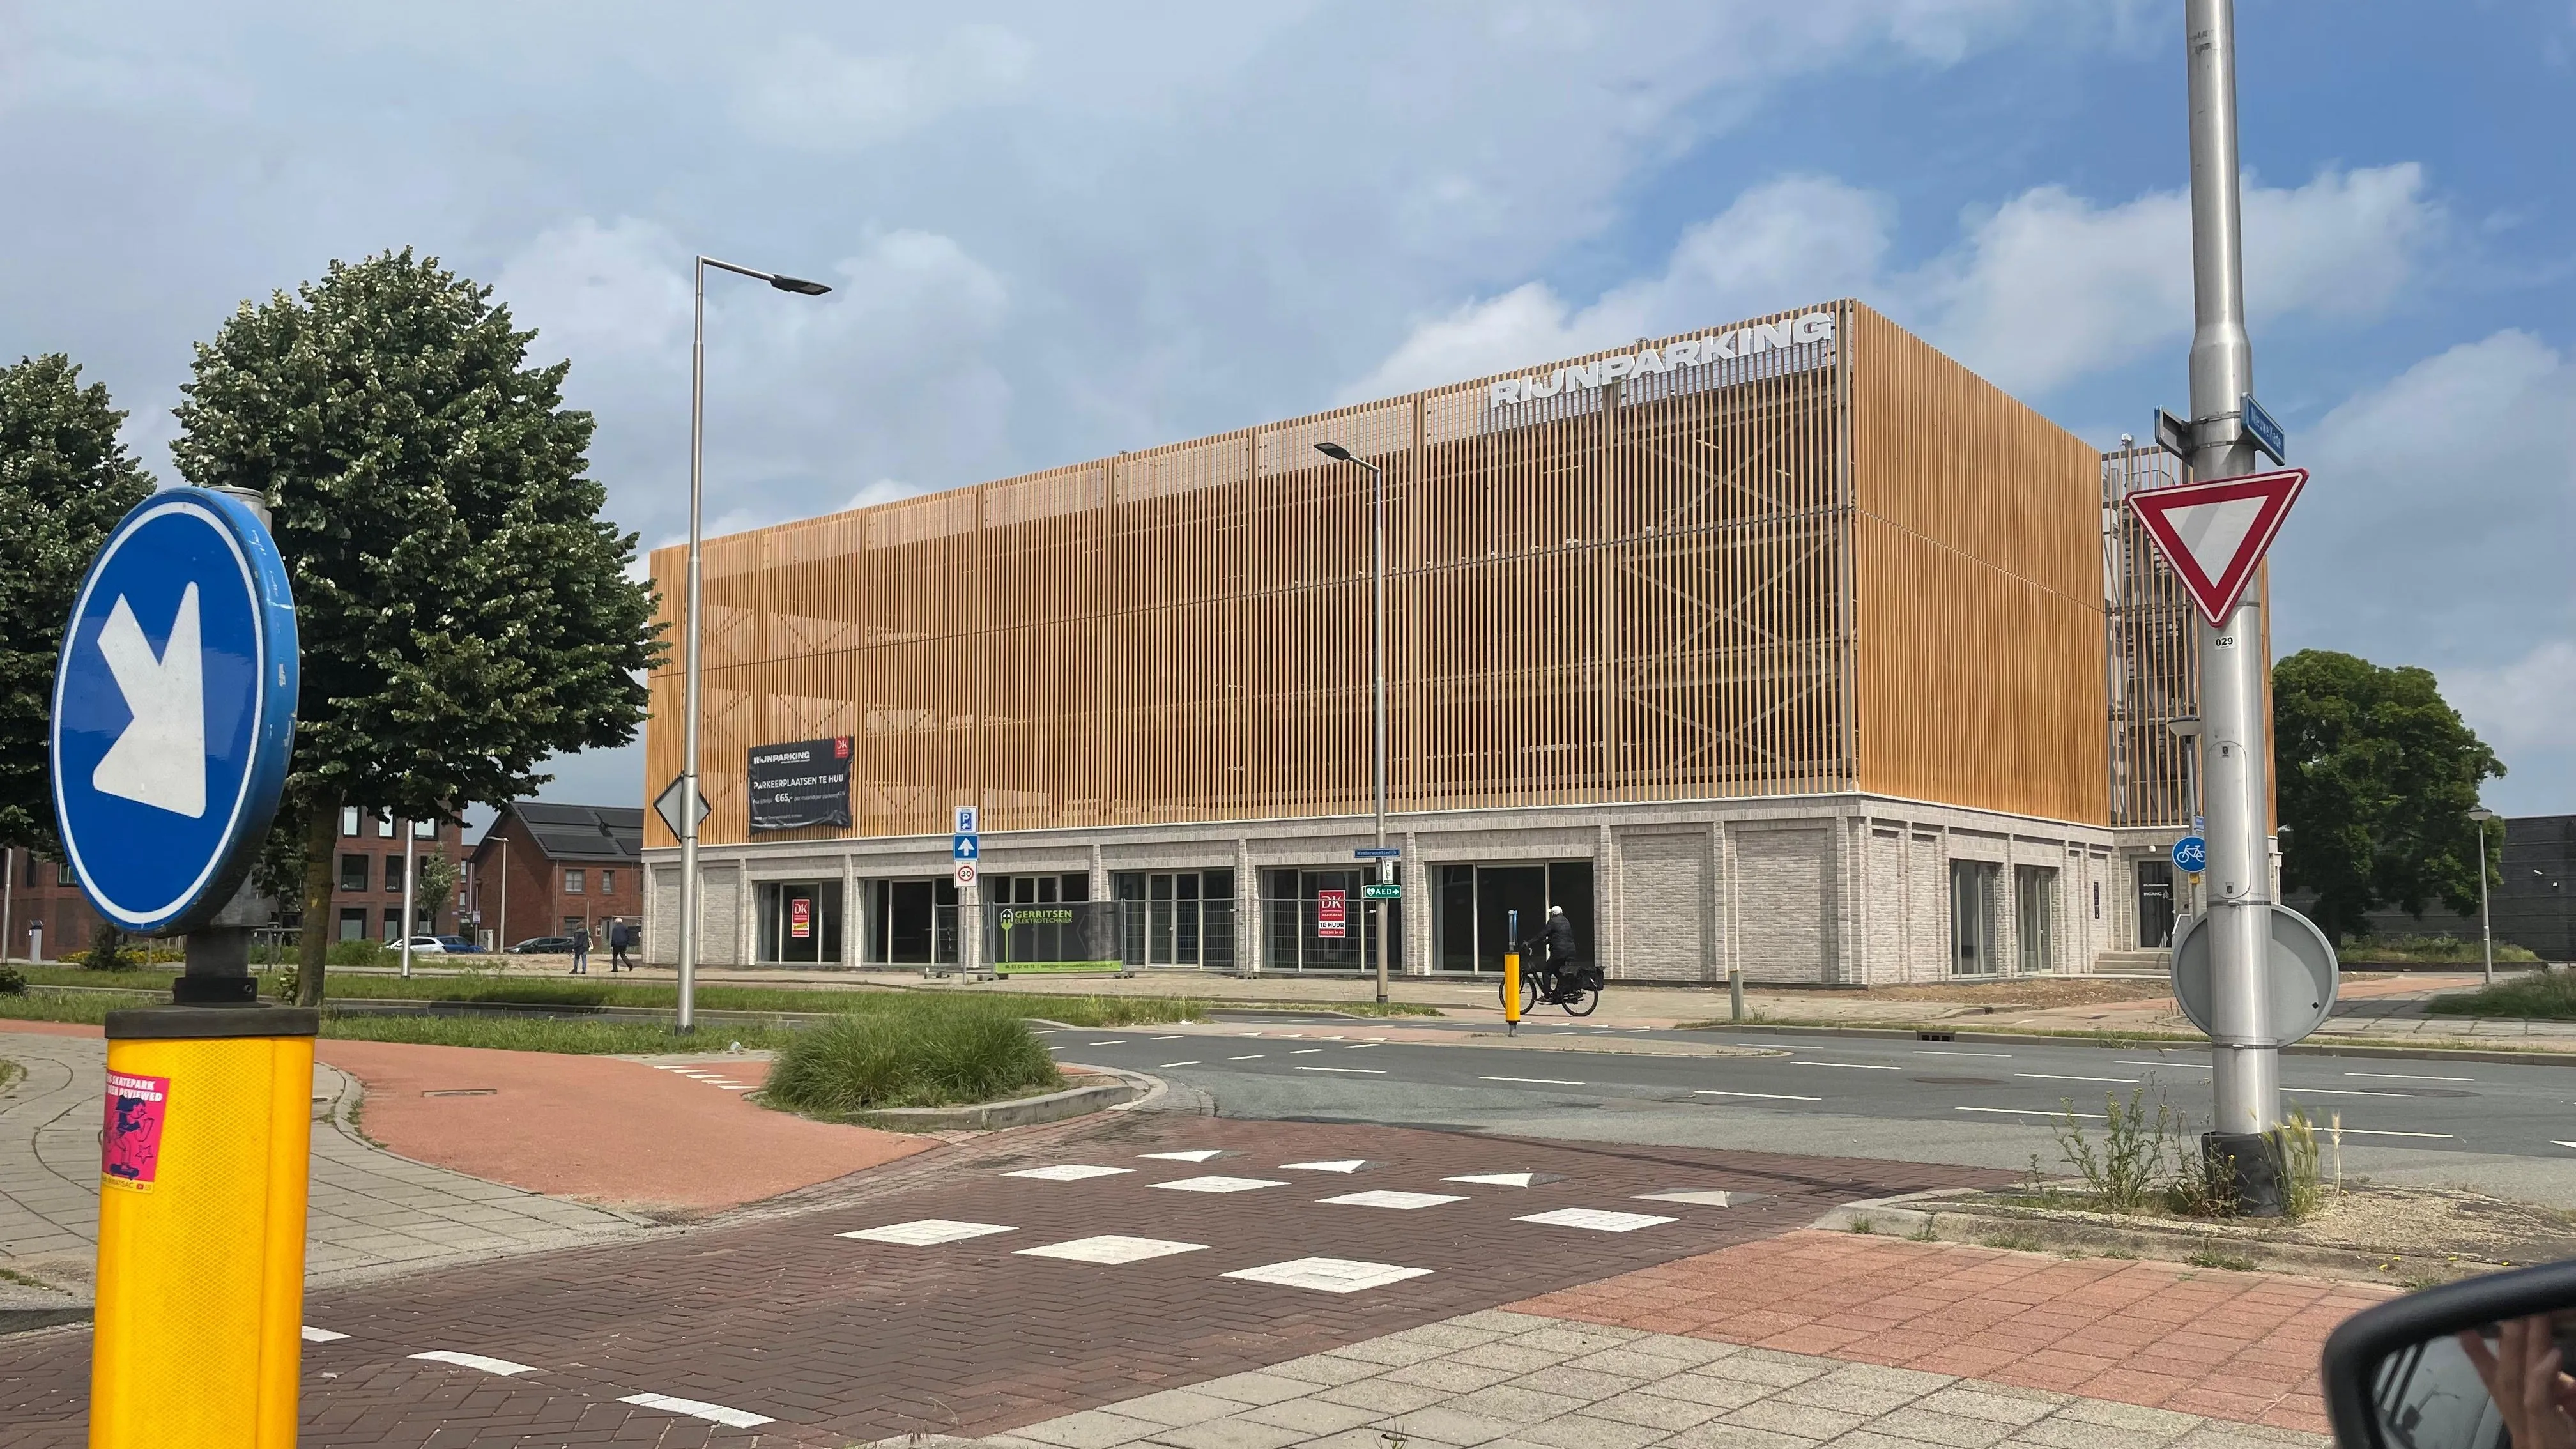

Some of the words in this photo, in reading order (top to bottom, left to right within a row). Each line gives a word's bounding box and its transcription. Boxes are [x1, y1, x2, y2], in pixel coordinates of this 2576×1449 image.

[1490, 312, 1833, 409] RIJNPARKING
[2216, 637, 2233, 646] 029
[753, 776, 817, 790] PARKEERPLAATSEN
[818, 775, 827, 784] TE
[829, 774, 843, 783] HUU
[962, 813, 970, 823] P
[1321, 896, 1342, 908] DK
[794, 903, 807, 914] DK
[1015, 910, 1073, 918] GERRITSEN
[112, 1075, 156, 1090] SKATEPARK
[119, 1088, 163, 1102] REVIEWED
